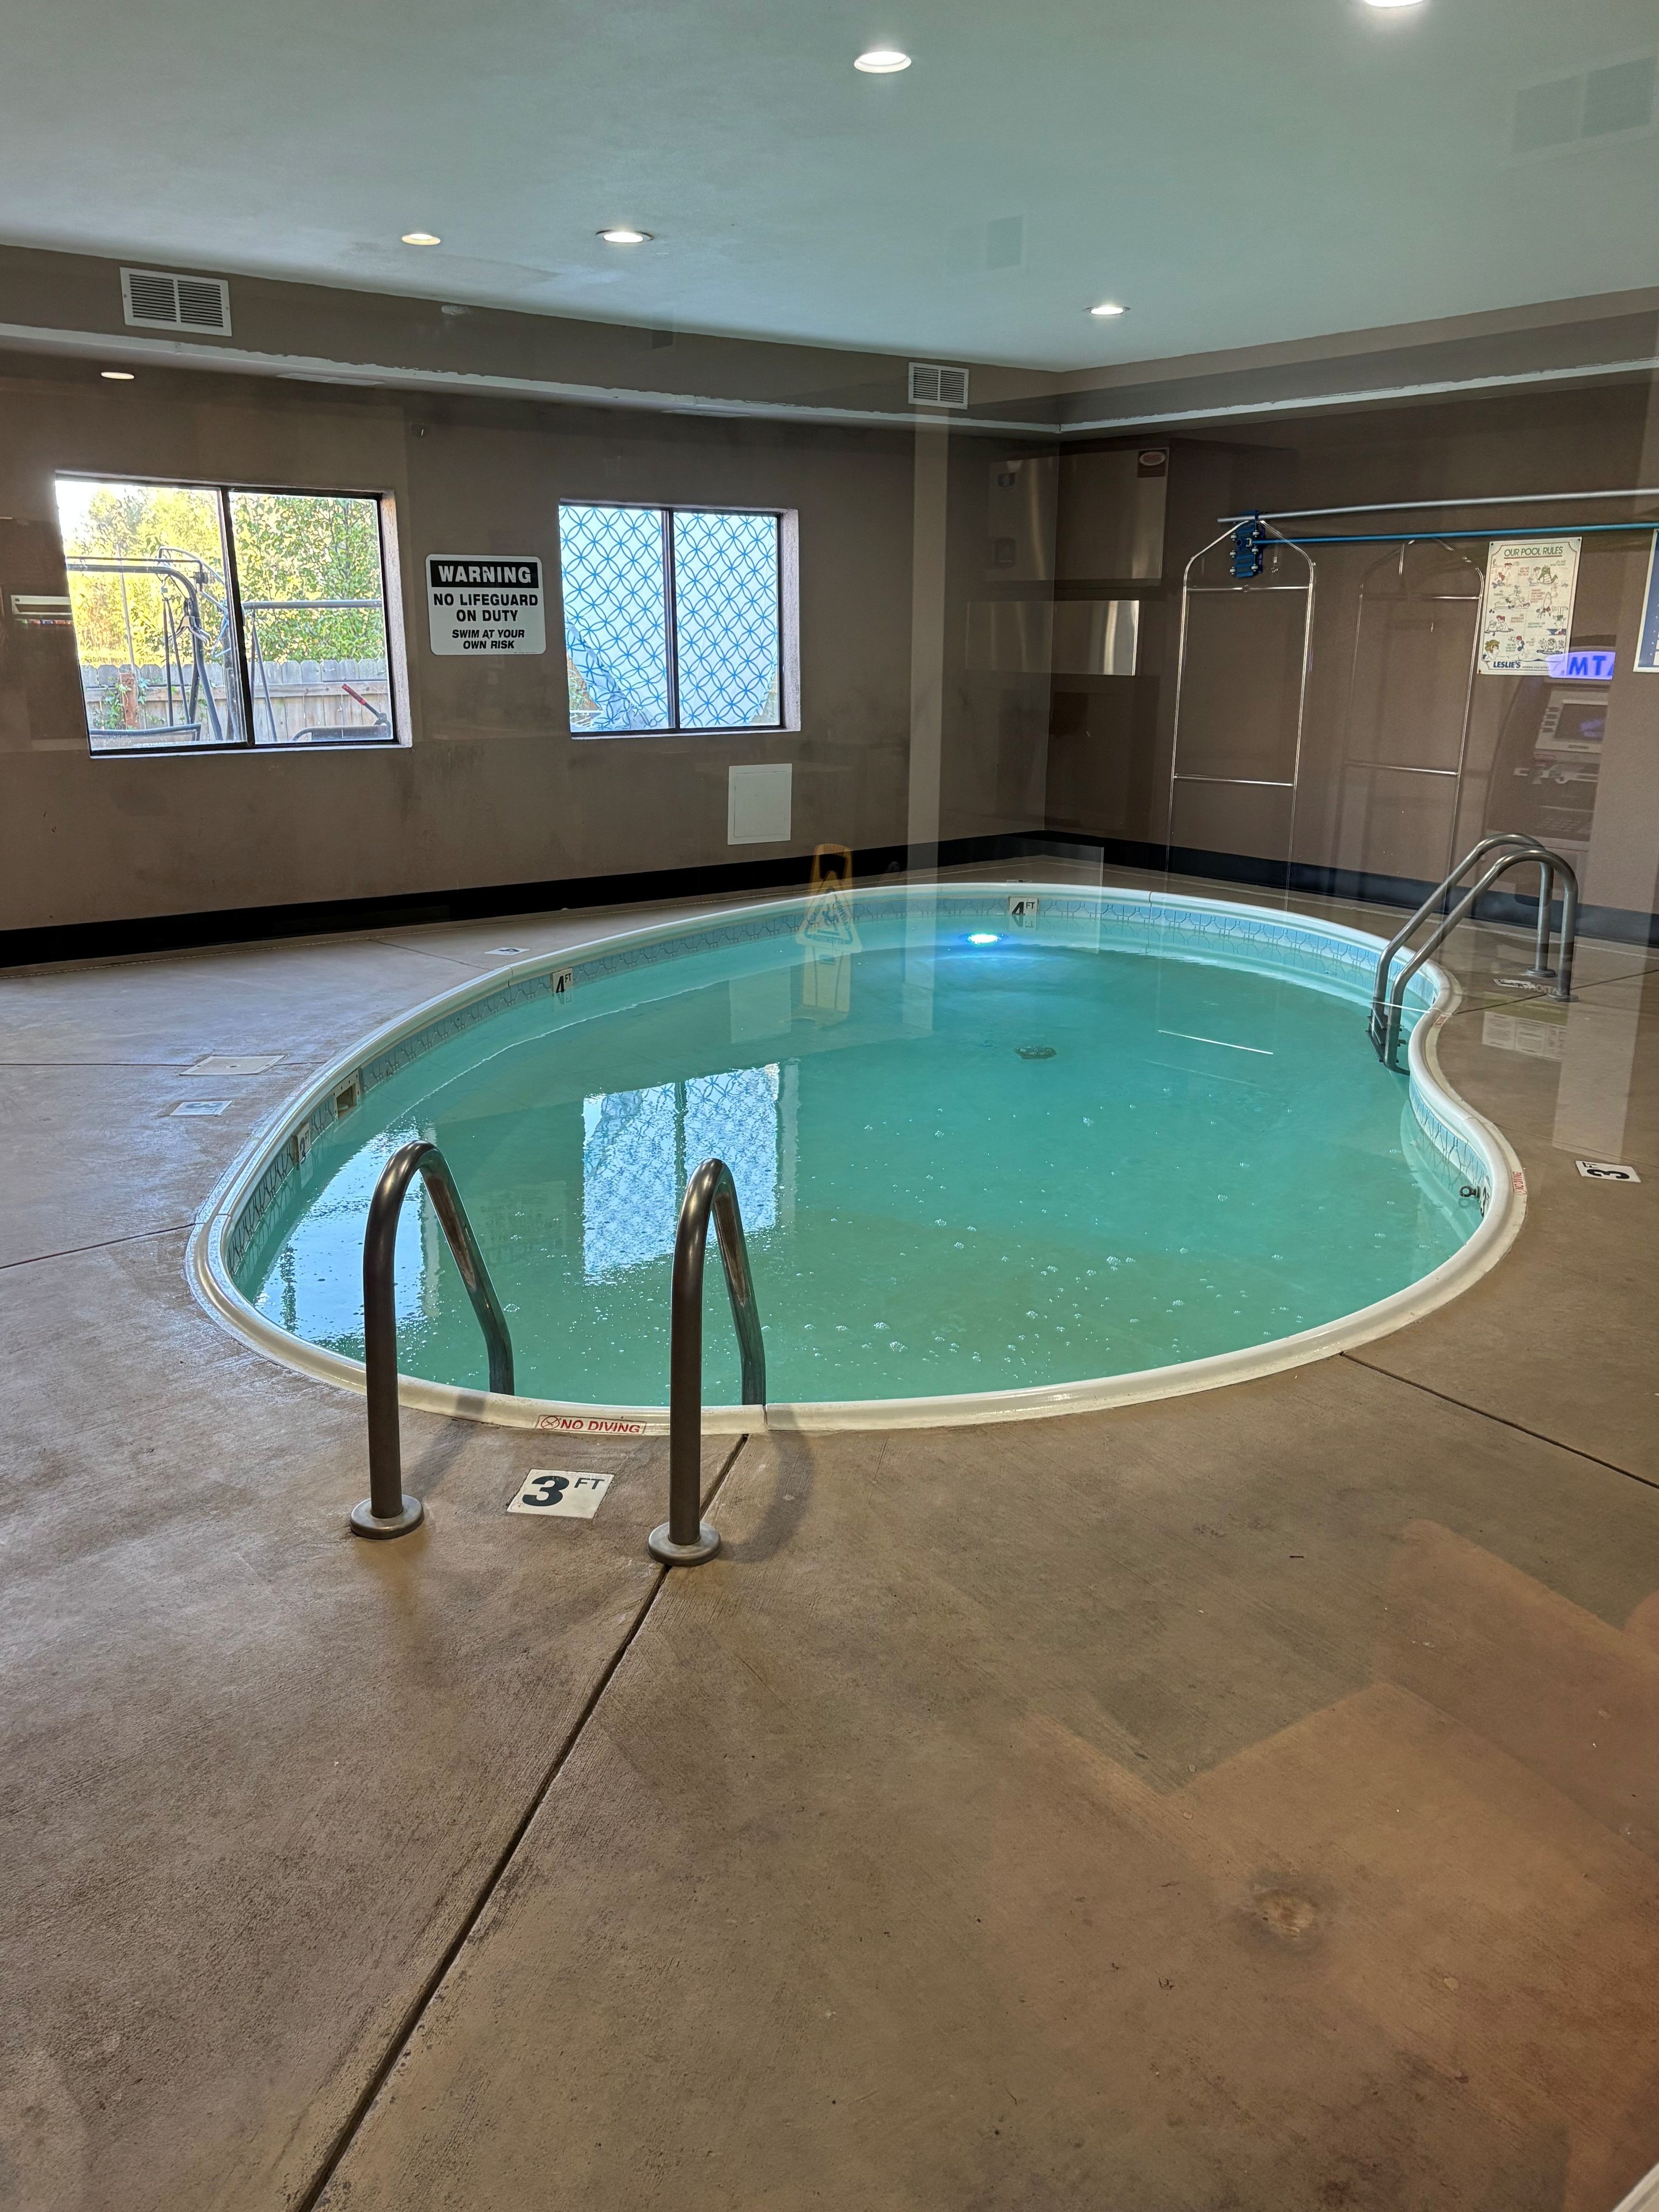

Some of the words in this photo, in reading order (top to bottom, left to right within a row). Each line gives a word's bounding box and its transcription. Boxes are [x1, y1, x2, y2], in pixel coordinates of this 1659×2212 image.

[1504, 548, 1519, 556] OUR
[1521, 547, 1541, 555] POOL
[1543, 546, 1563, 554] RULES
[438, 565, 531, 583] WARNING
[433, 593, 454, 605] NO
[459, 594, 539, 606] LIFEGUARD
[456, 609, 477, 622] ON
[482, 610, 518, 622] DUTY
[452, 629, 480, 638] SWIM
[482, 629, 495, 639] AT
[497, 629, 525, 638] YOUR
[463, 640, 487, 649] OWN
[490, 640, 515, 649] RISK
[1012, 902, 1025, 915] 4
[1026, 902, 1035, 910] FT
[556, 976, 566, 994] 4
[565, 973, 572, 983] FT
[1586, 1169, 1630, 1179] 3
[559, 1419, 584, 1430] NO
[587, 1421, 641, 1433] DIVING
[522, 1475, 570, 1507] 3
[574, 1478, 605, 1490] FT
